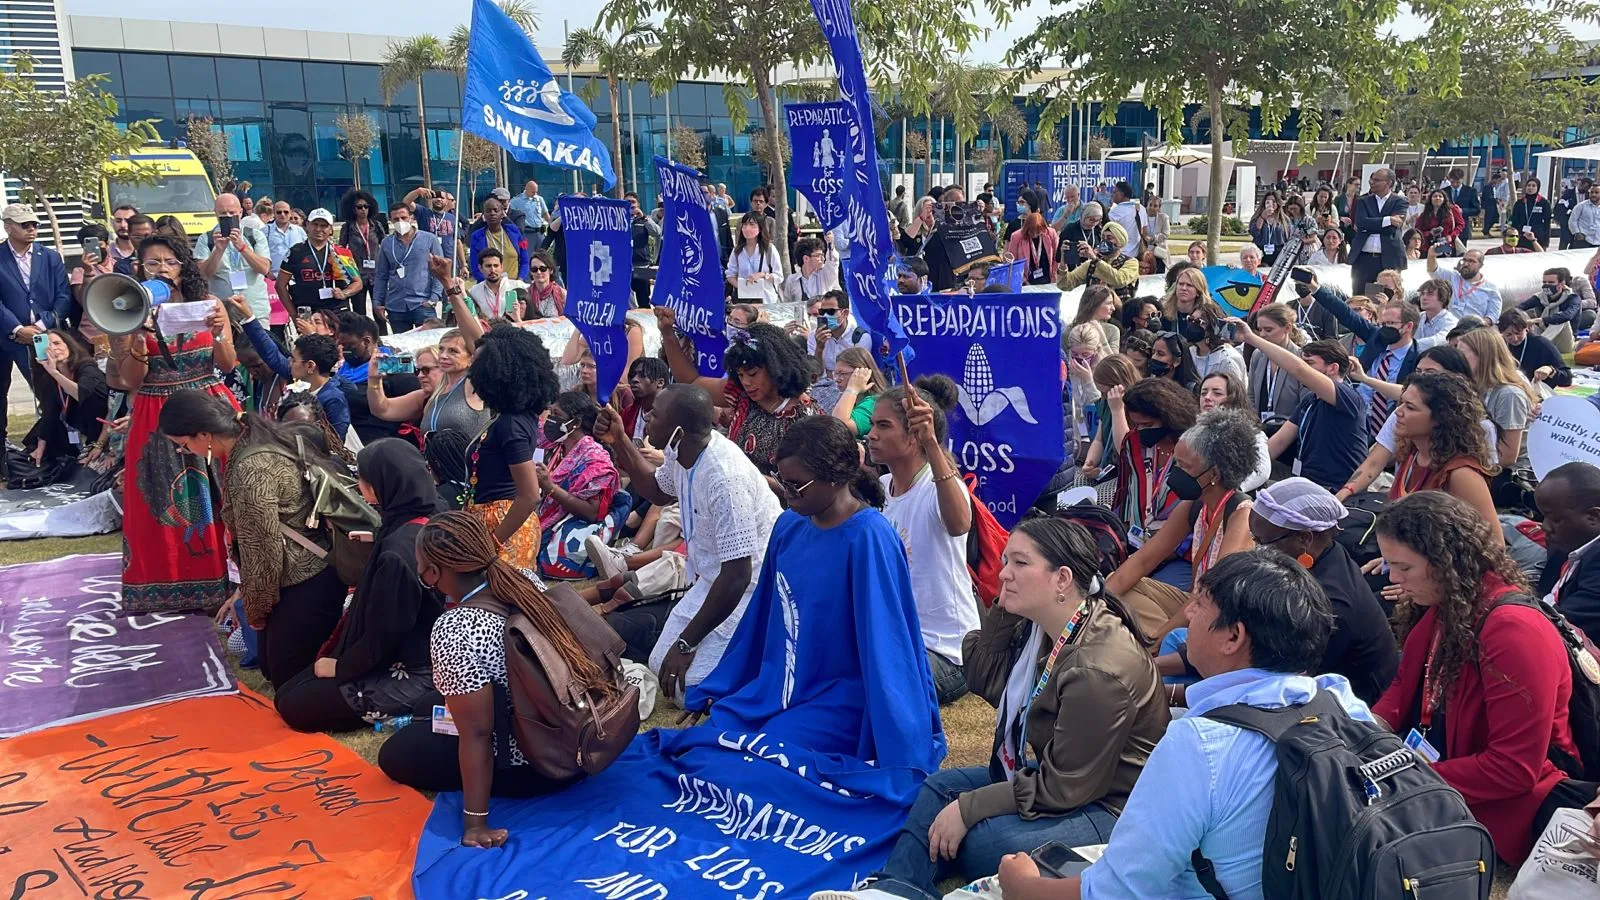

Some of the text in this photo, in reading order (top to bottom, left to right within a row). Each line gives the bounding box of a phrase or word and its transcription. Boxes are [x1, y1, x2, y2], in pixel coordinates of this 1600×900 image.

[483, 104, 604, 177] SANLAKAS
[812, 178, 844, 195] LOSS
[564, 205, 629, 233] REPARATIONS
[818, 200, 843, 226] life
[576, 300, 616, 327] STOLEN
[664, 293, 716, 338] DAMAGE
[898, 303, 1058, 339] REPARATIONS
[1535, 411, 1553, 424] Act
[1552, 416, 1588, 438] justly,
[1550, 431, 1576, 447] walk
[948, 438, 1015, 473] LOSS
[661, 773, 867, 862] REPARATIONS
[592, 821, 786, 900] FOR LOSS
[1561, 863, 1592, 880] EGYPT
[572, 871, 669, 900] AND
